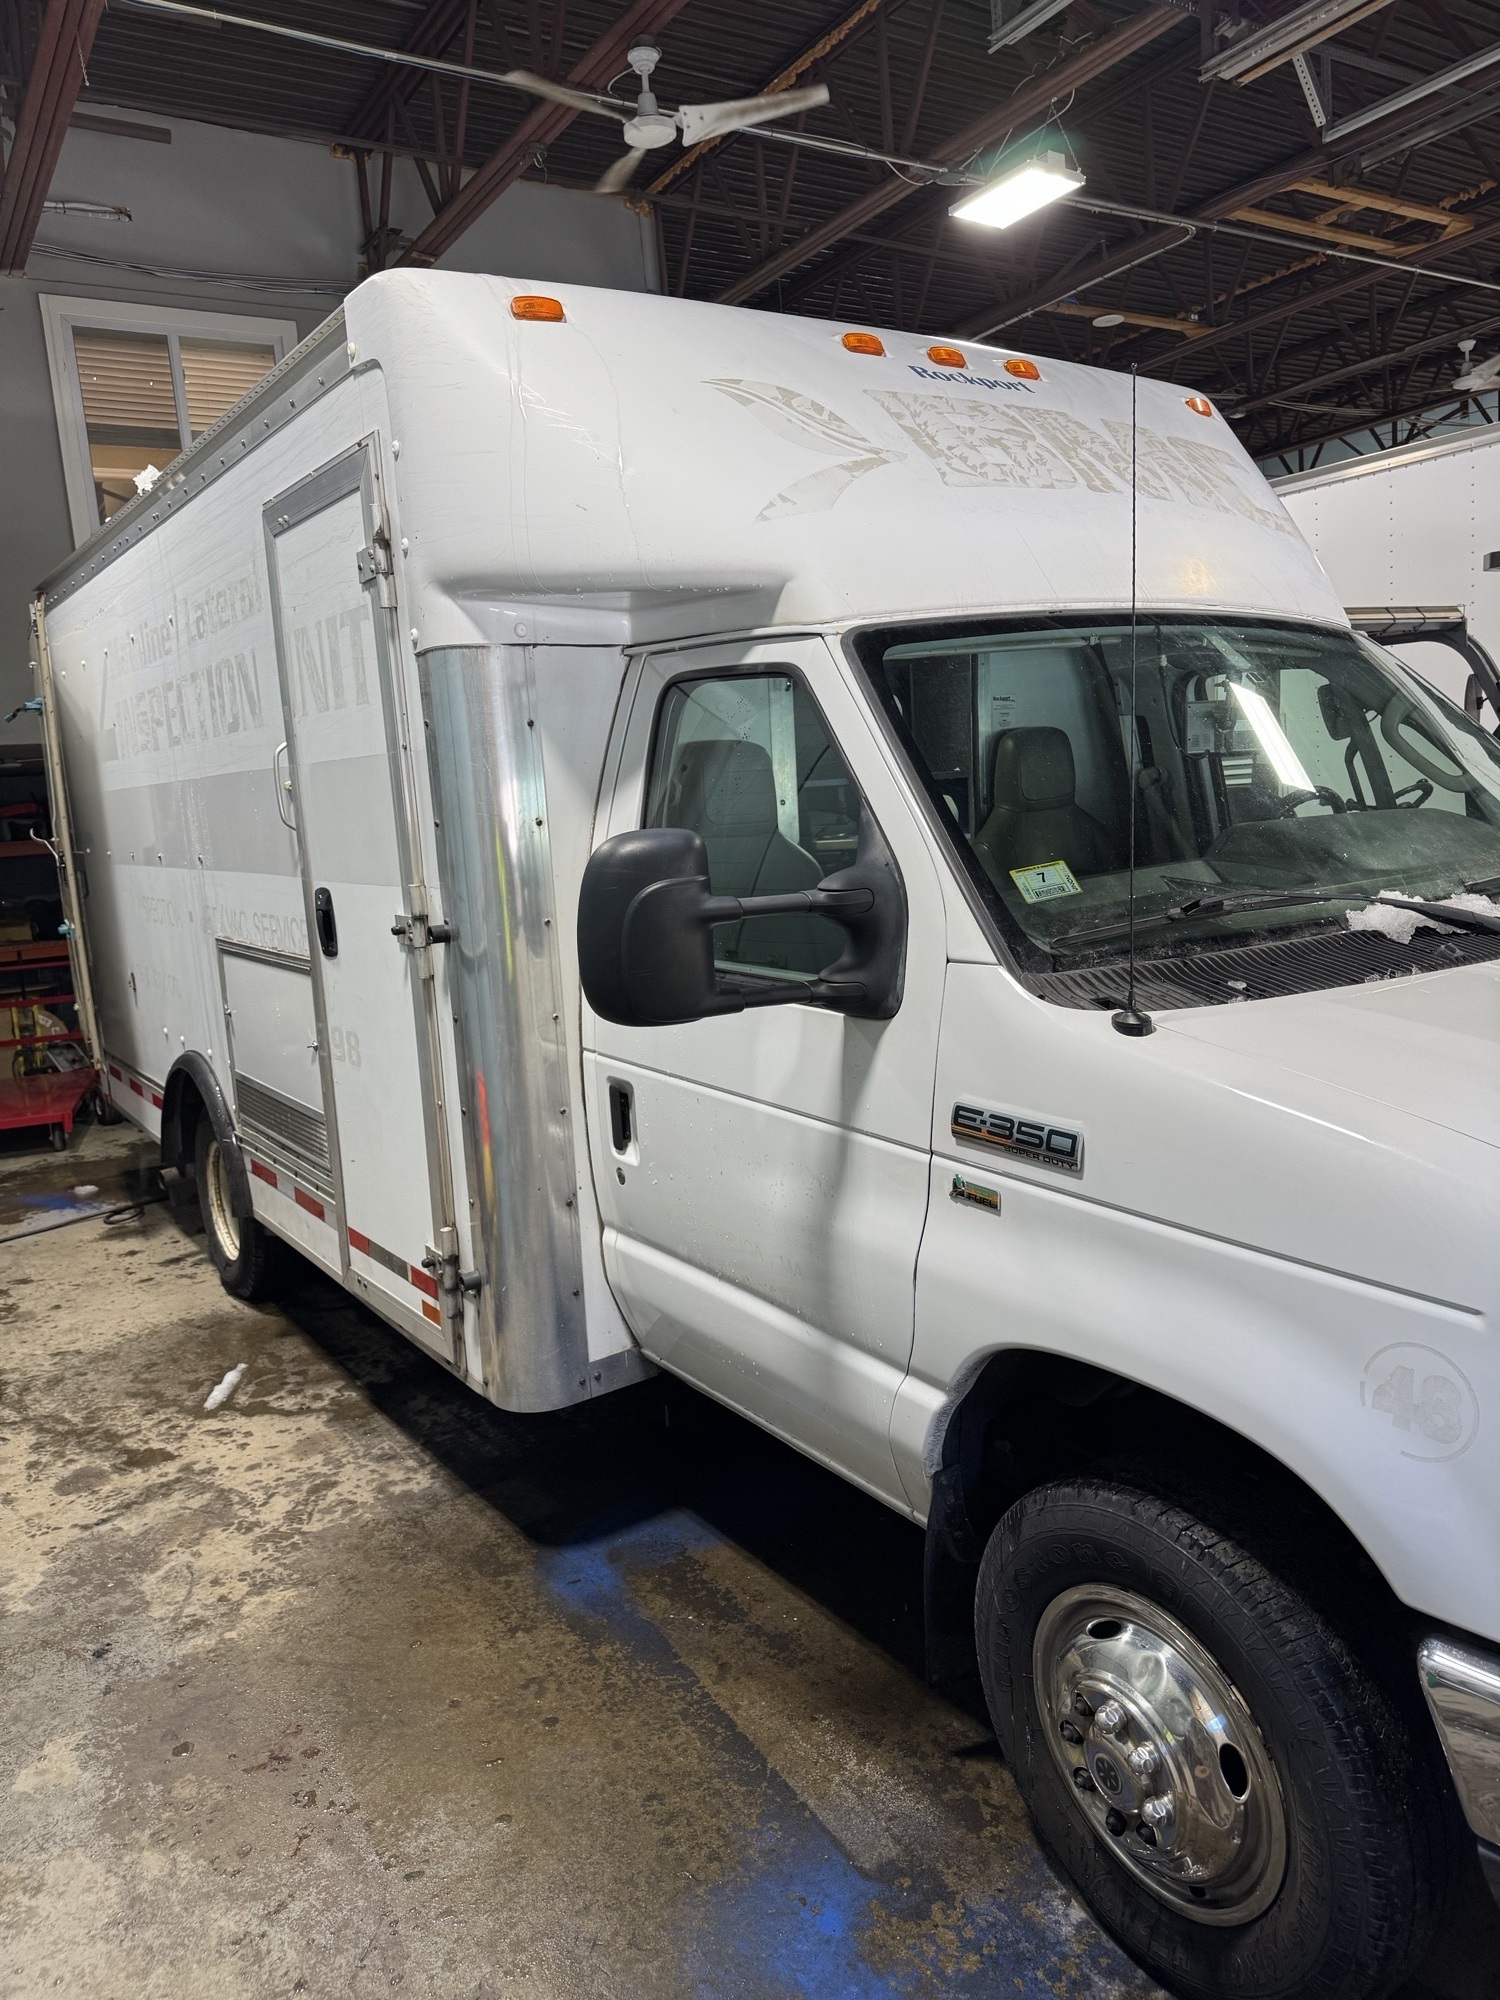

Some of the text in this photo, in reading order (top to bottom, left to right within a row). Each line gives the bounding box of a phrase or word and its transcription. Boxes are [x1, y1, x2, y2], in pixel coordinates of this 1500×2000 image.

[907, 365, 1036, 394] Rockport
[1036, 872, 1046, 884] 7
[1003, 1145, 1078, 1170] SUPER DUTY
[967, 1192, 999, 1209] FUEL
[1371, 1364, 1463, 1445] 48
